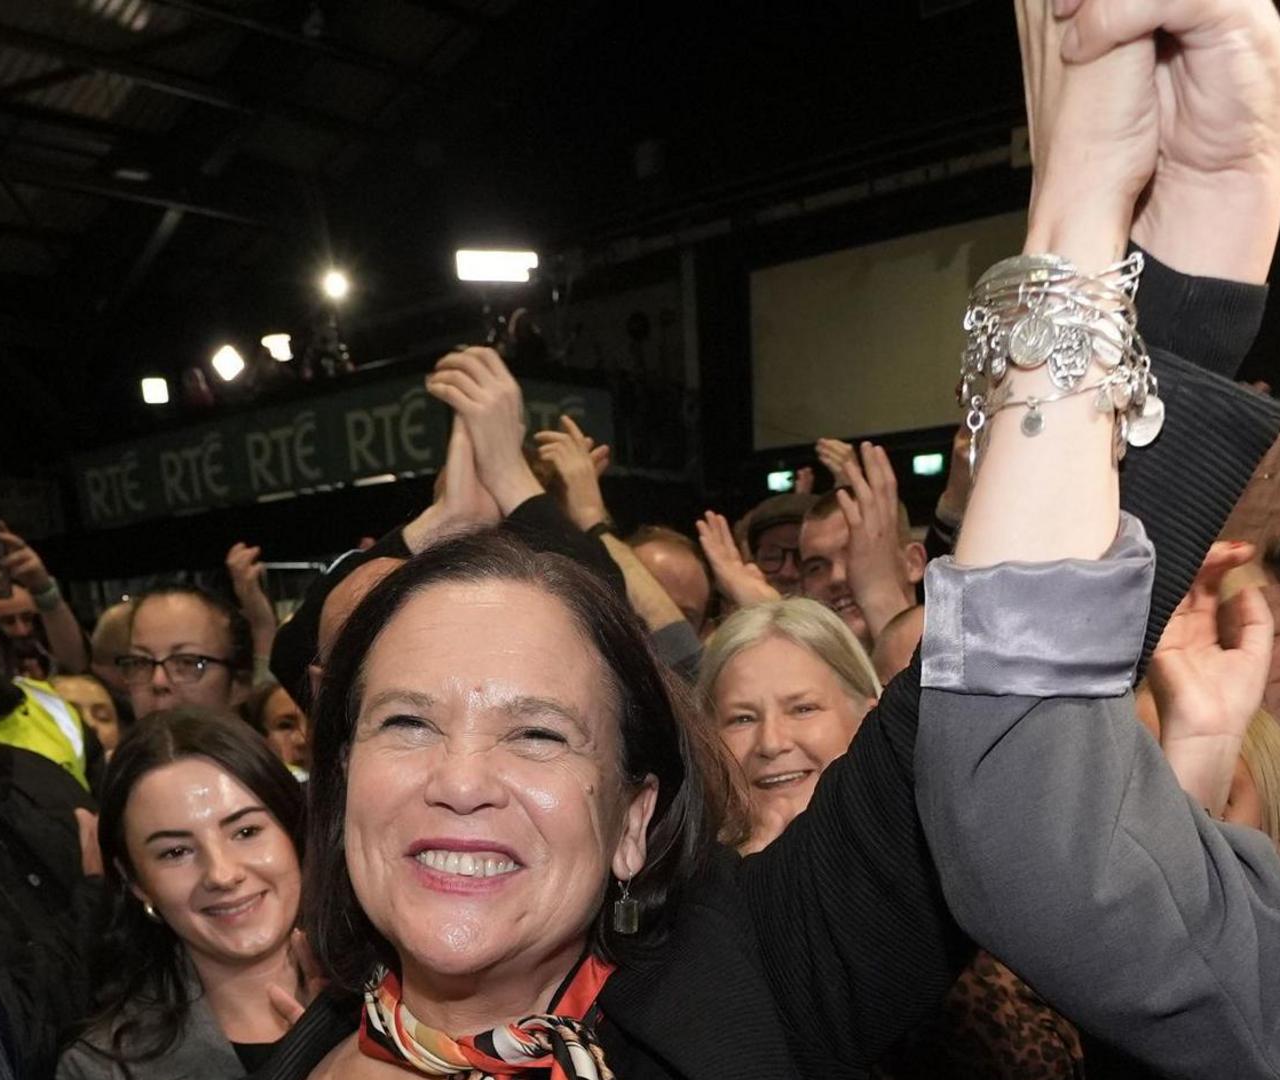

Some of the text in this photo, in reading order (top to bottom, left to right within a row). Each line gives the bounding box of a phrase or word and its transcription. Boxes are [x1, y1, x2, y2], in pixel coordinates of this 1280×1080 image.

[84, 454, 146, 522] RTÉ
[160, 432, 229, 505] RTÉ
[245, 411, 322, 491] RTÉ
[345, 389, 432, 471] RTÉ
